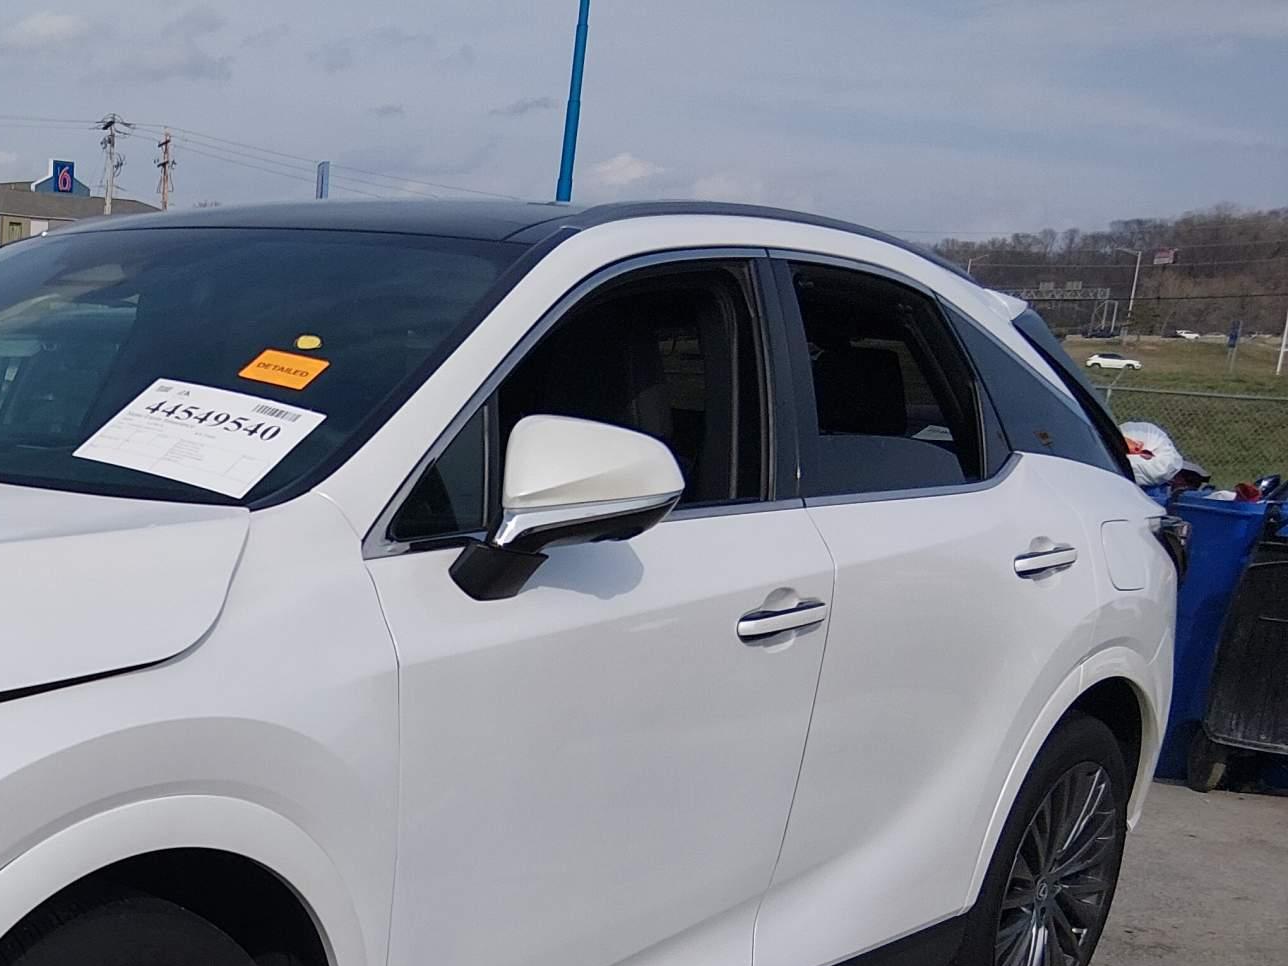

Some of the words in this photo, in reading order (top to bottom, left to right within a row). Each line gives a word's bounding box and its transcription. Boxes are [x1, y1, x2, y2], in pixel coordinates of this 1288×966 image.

[58, 166, 72, 192] 6
[257, 361, 310, 378] DETAILED
[144, 400, 281, 441] 44549540
